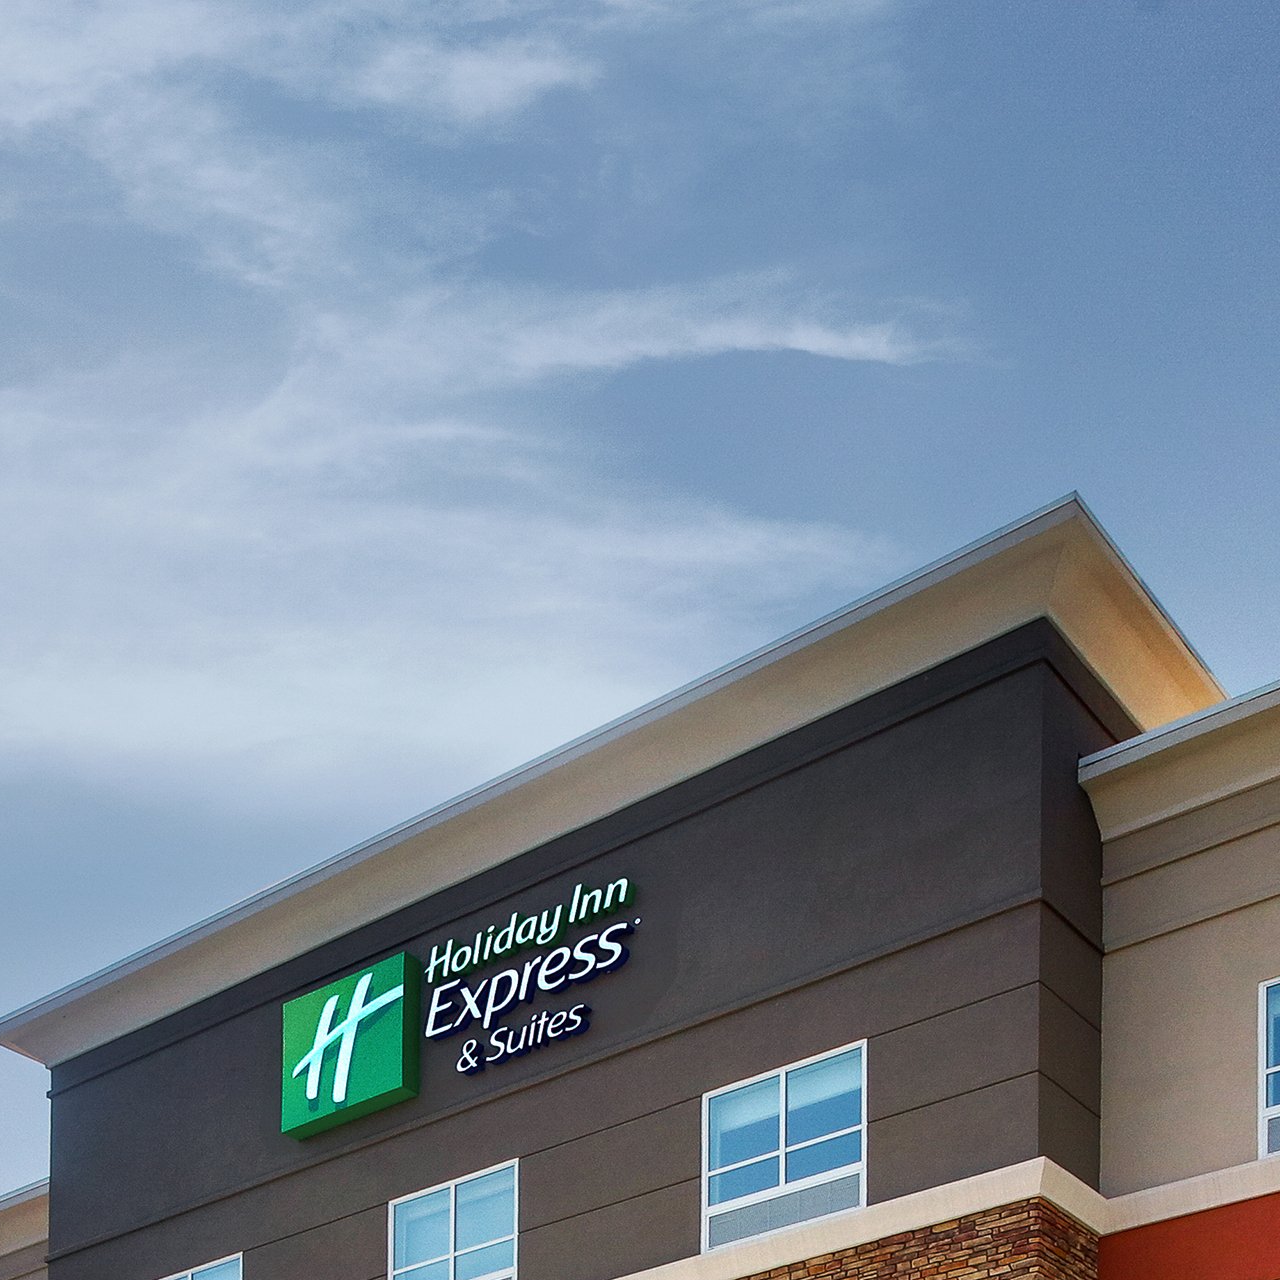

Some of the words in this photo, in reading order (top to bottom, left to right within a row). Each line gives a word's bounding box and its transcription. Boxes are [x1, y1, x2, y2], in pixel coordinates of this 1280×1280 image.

[424, 904, 563, 983] Holiday
[568, 878, 629, 923] Inn
[425, 922, 629, 1038] Express
[456, 1039, 479, 1073] &
[486, 1004, 586, 1062] Suites
